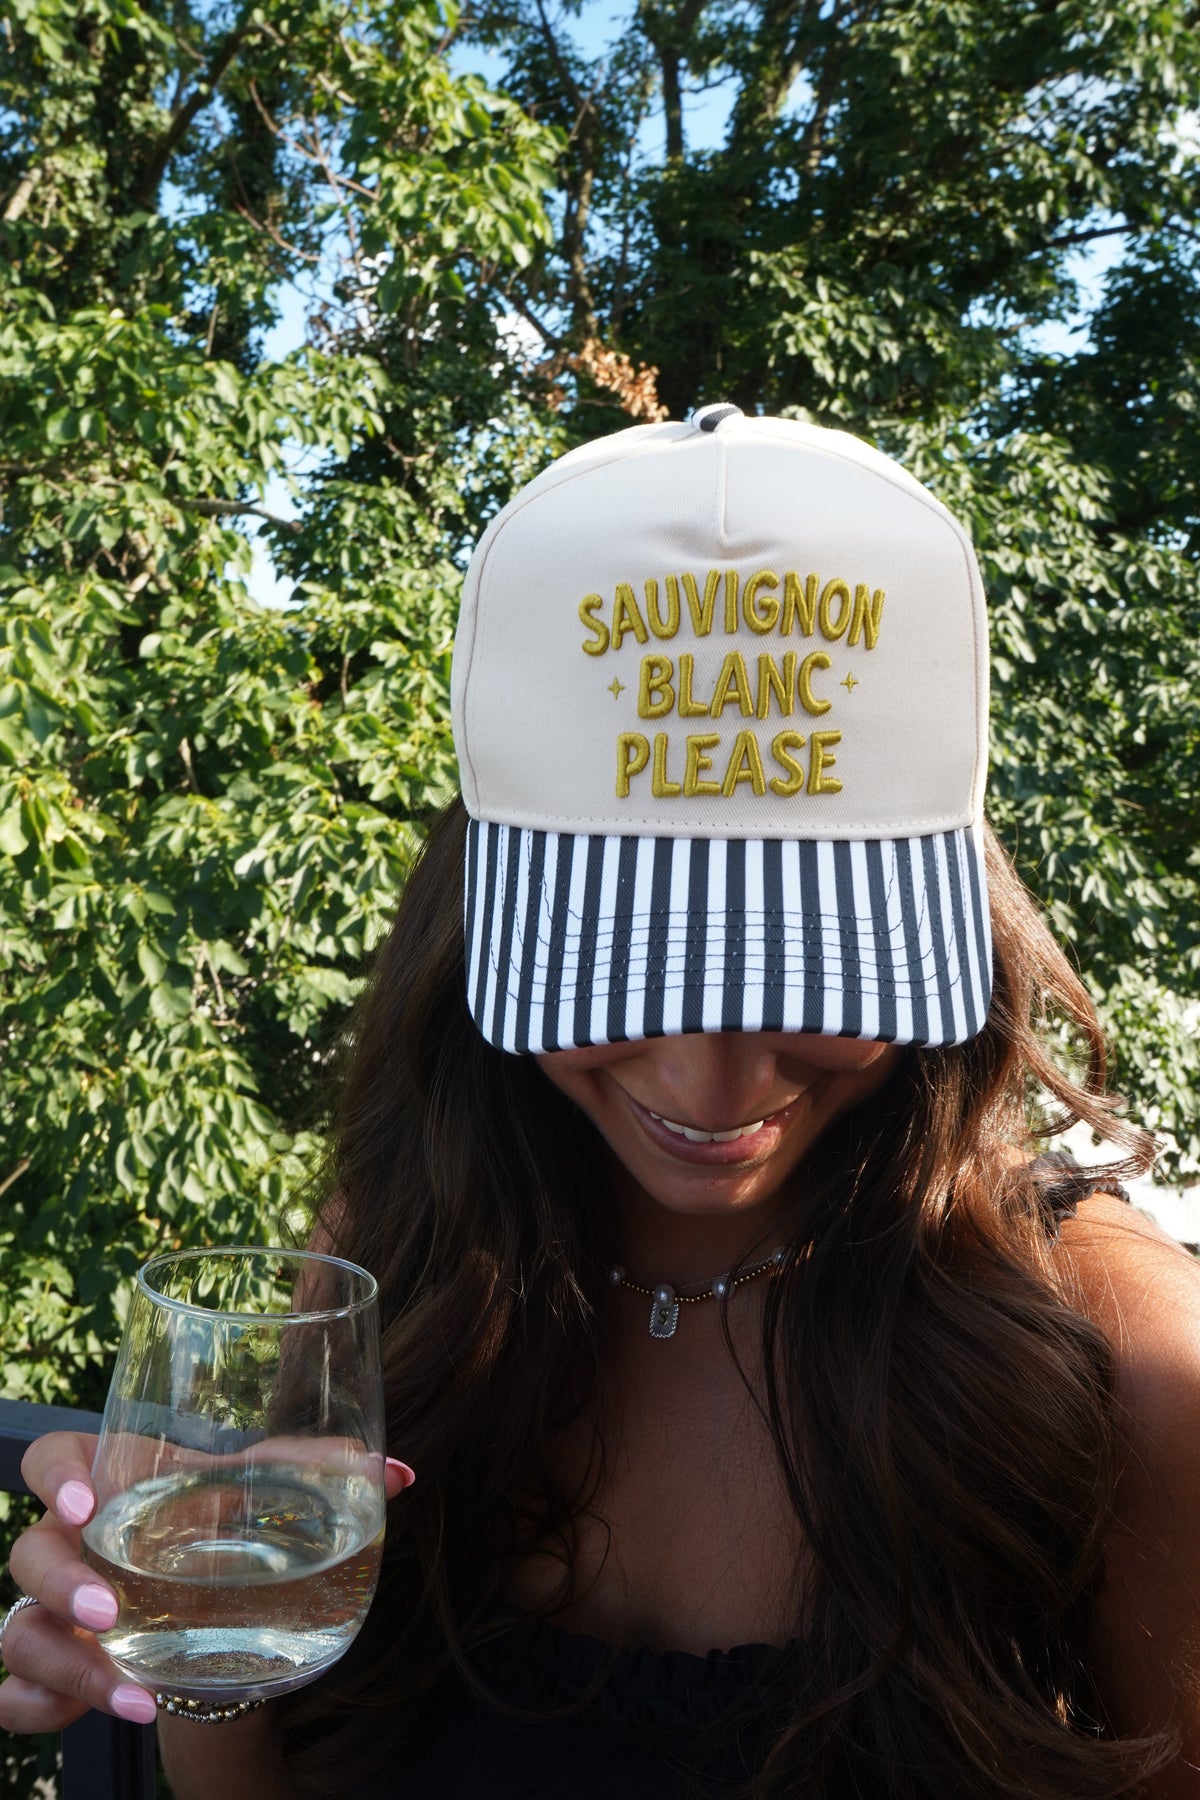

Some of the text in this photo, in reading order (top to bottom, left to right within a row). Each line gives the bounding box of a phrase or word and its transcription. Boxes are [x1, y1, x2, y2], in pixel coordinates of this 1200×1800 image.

[578, 569, 885, 656] SAUVIGNON
[637, 650, 832, 720] BLANC
[615, 729, 843, 798] PLEASE
[657, 1308, 670, 1326] S
